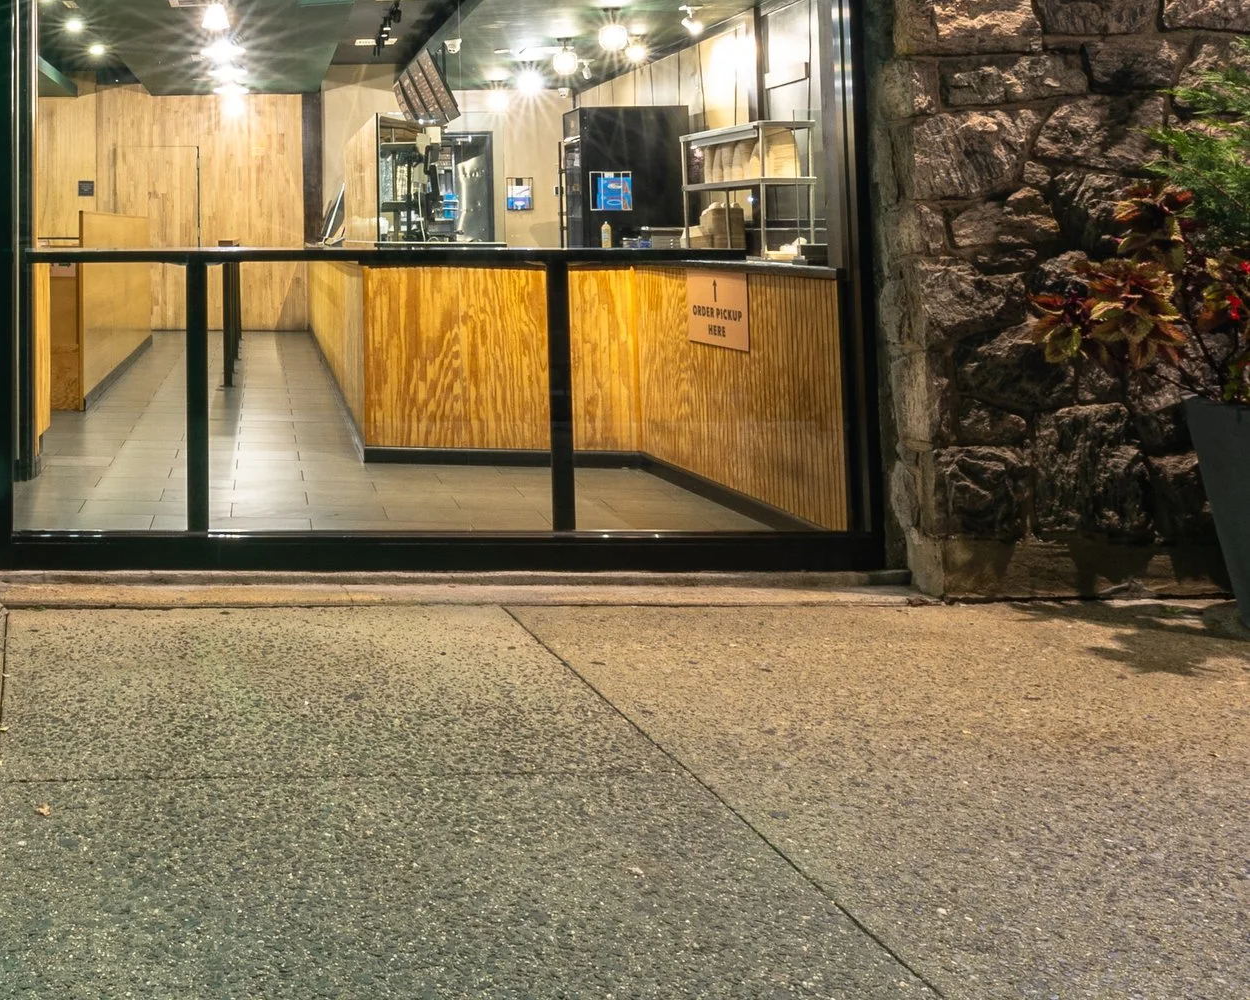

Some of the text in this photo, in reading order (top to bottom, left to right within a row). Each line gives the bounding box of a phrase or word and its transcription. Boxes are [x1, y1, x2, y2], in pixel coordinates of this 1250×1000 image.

[693, 305, 742, 322] ORDER PICKUP
[708, 324, 726, 337] HERE
